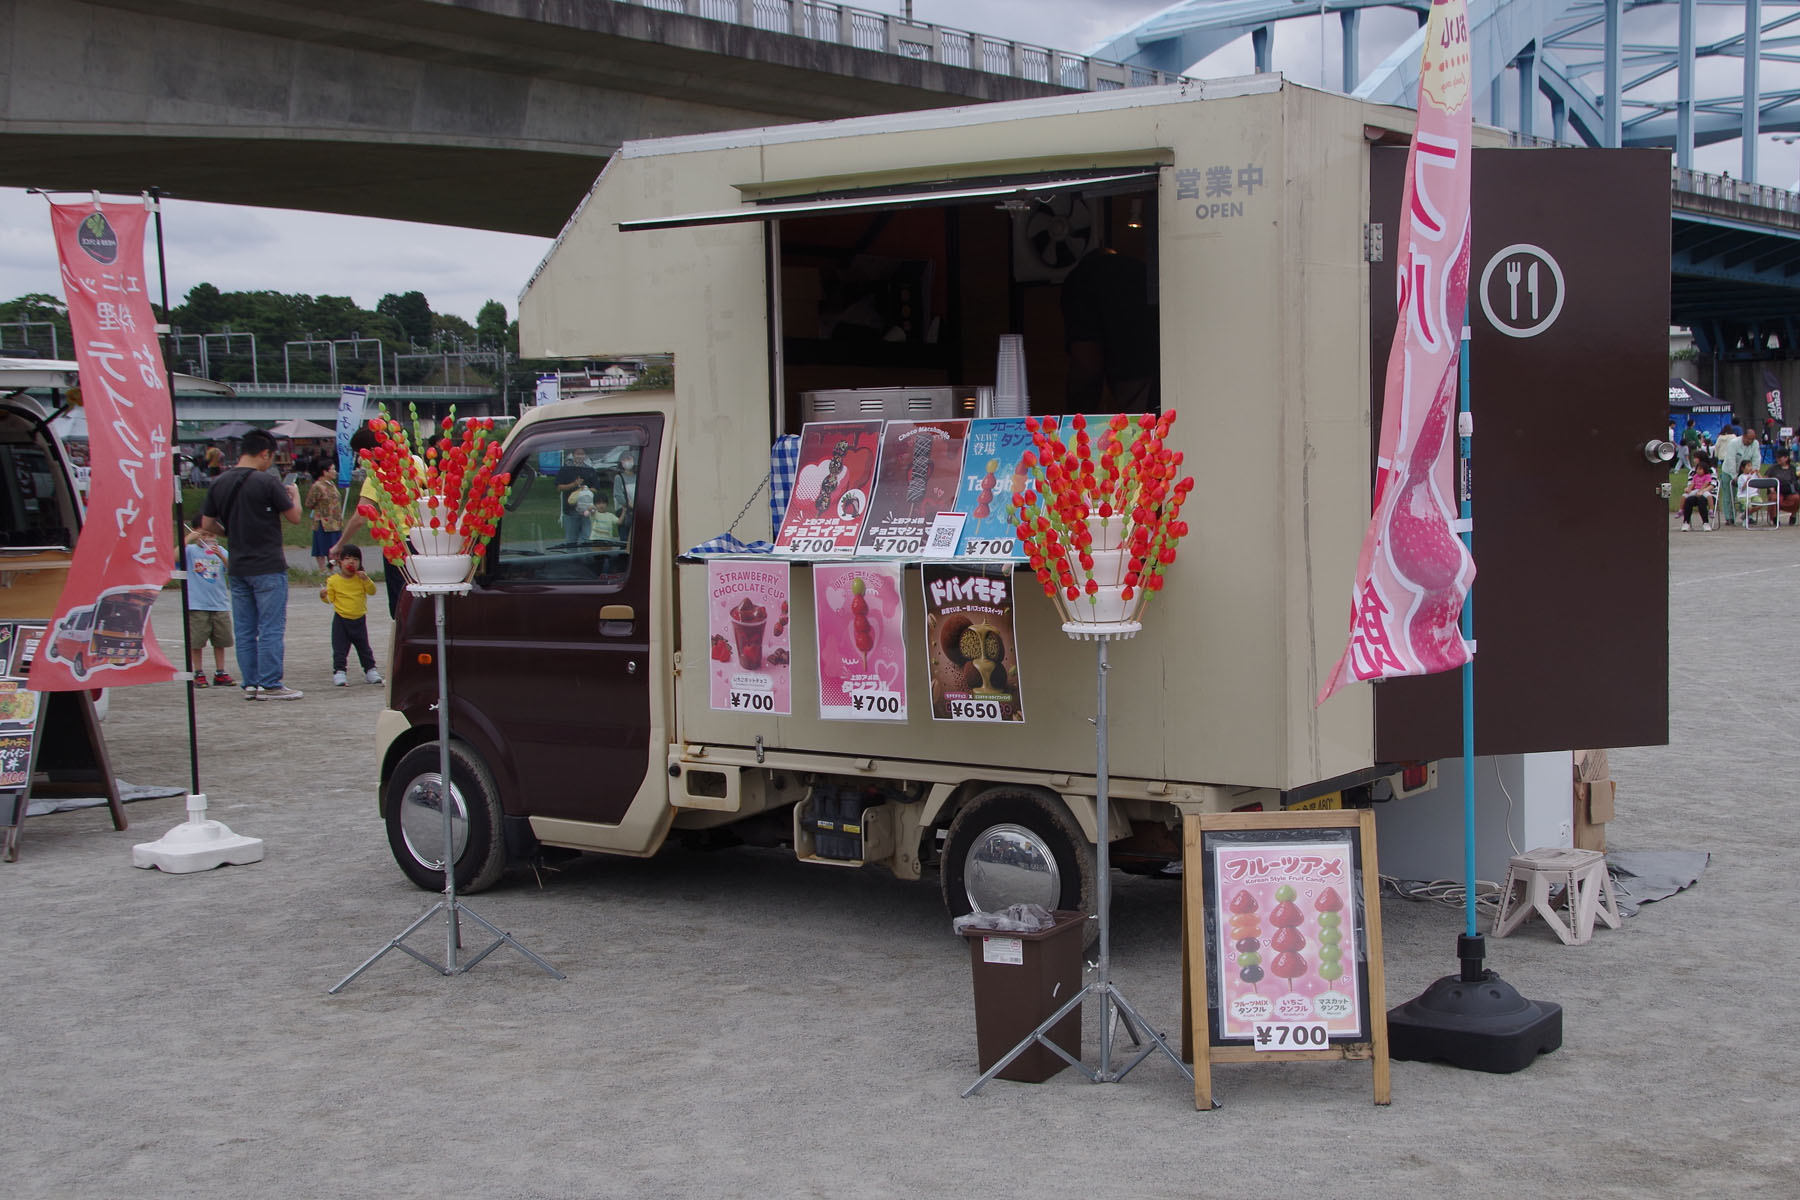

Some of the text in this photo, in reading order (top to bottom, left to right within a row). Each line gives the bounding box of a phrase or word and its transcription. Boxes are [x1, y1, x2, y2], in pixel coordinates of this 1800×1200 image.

[1175, 163, 1263, 200] 営業中
[1195, 202, 1244, 219] OPEN
[989, 421, 1026, 432] フローズ
[898, 428, 918, 441] Choco
[1001, 433, 1037, 447] タンフ
[973, 442, 996, 456] 登場
[784, 522, 859, 537] チョコイチゴ
[789, 539, 834, 553] ¥700
[873, 538, 919, 554] ¥700
[966, 540, 1014, 555] ¥700
[719, 571, 779, 585] STRAWBERRY
[713, 583, 785, 600] CHOCOLATE CUP
[930, 576, 1007, 606] ドバイモチ
[841, 680, 890, 693] タンフル
[731, 692, 774, 711] ¥700
[853, 694, 899, 713] ¥700
[952, 702, 998, 719] ¥650
[1225, 856, 1343, 880] フルーツアメ
[1245, 877, 1269, 885] Korean
[1305, 876, 1326, 884] Candy
[1234, 1000, 1269, 1008] フルーツMIX
[1319, 997, 1349, 1005] マスカット
[1320, 1003, 1346, 1012] タンフル
[1238, 1006, 1267, 1015] タンフル
[1280, 1004, 1308, 1013] タンフル
[1256, 1026, 1327, 1045] ¥700
